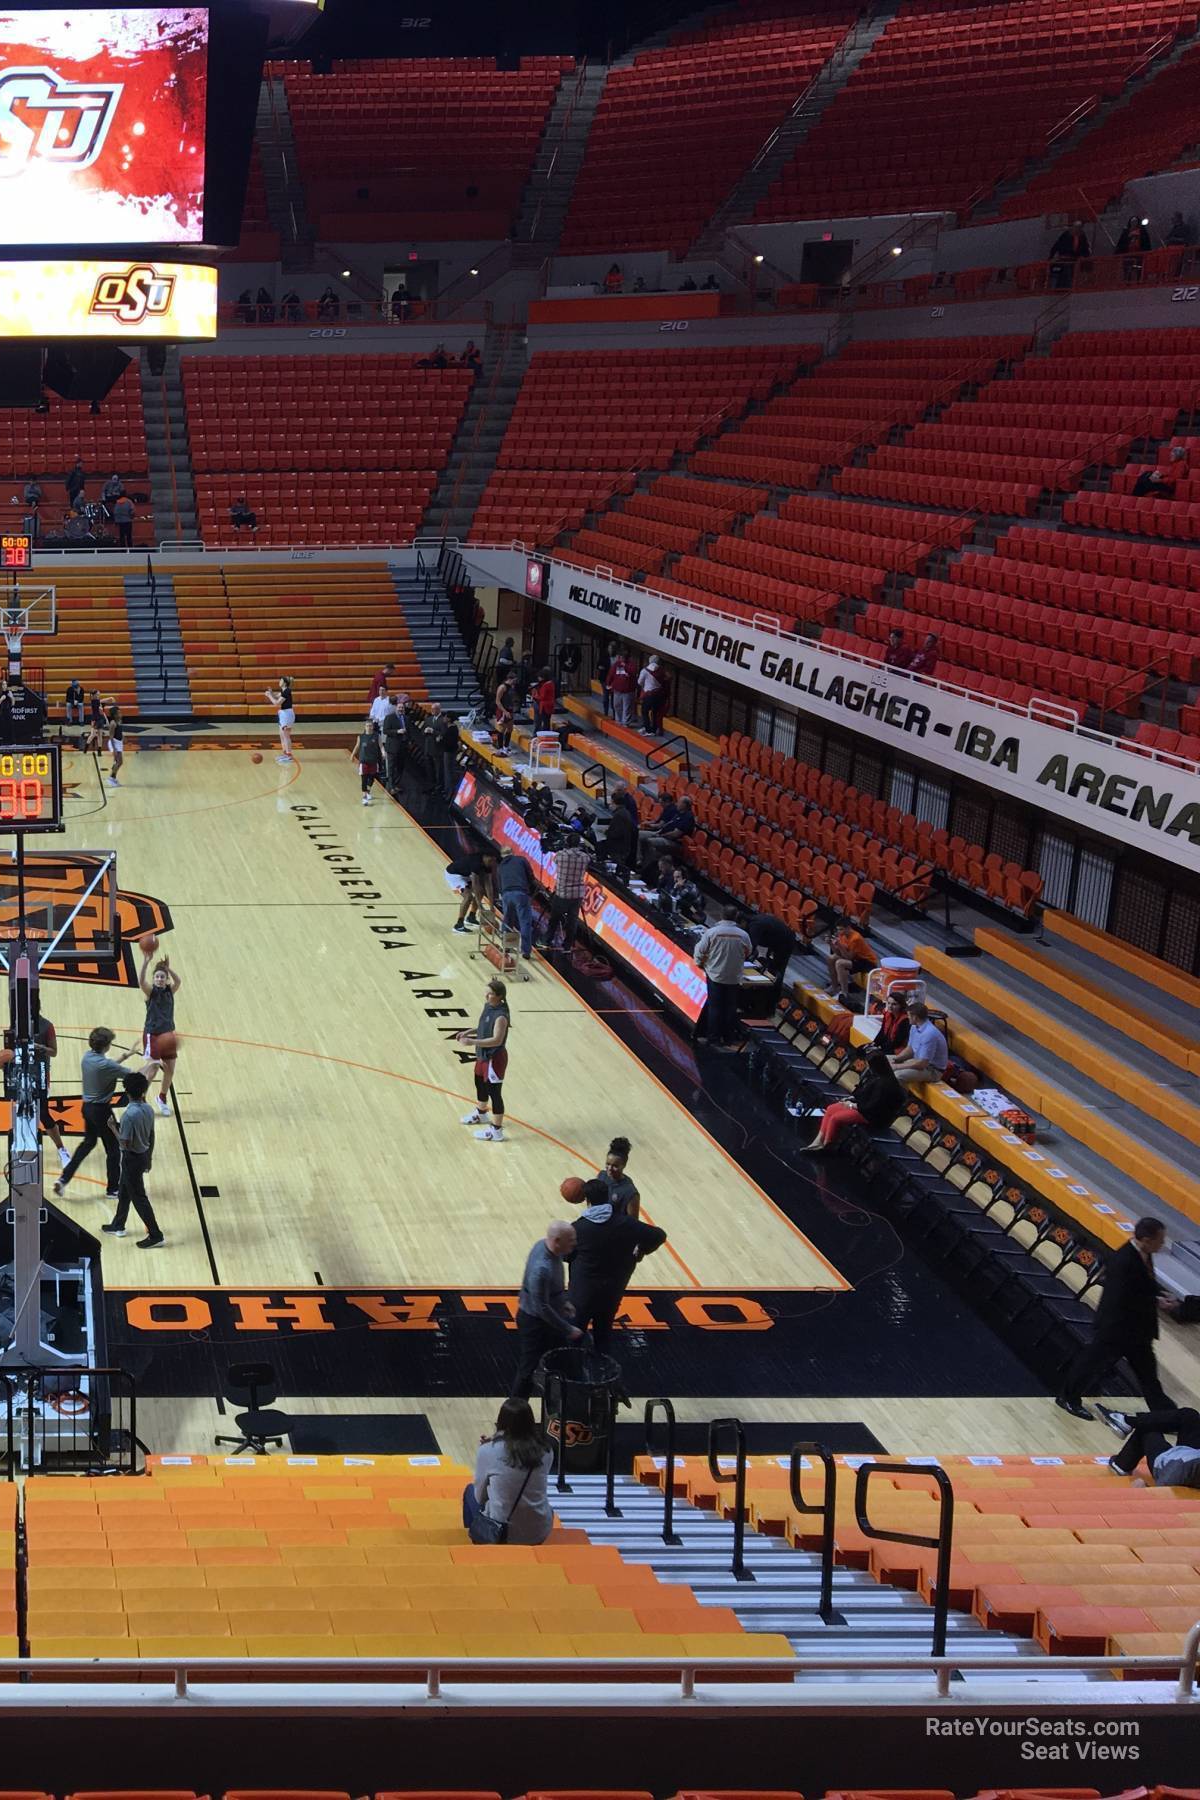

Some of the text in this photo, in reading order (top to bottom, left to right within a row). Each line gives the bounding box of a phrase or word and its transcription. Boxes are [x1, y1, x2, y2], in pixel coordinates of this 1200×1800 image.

[400, 17, 432, 28] 312
[89, 264, 177, 325] OSU
[1172, 287, 1198, 301] 212
[931, 306, 944, 318] 211
[660, 320, 689, 331] 210
[309, 328, 347, 338] 209
[2, 537, 29, 548] 60:00
[568, 584, 1200, 847] WELCOME TO HISTORIC GALLAGHER-IBA ARENA
[290, 804, 418, 950] GALLAGHER-IBA
[602, 902, 672, 977] OKLAHOMA
[668, 961, 708, 1008] STAT
